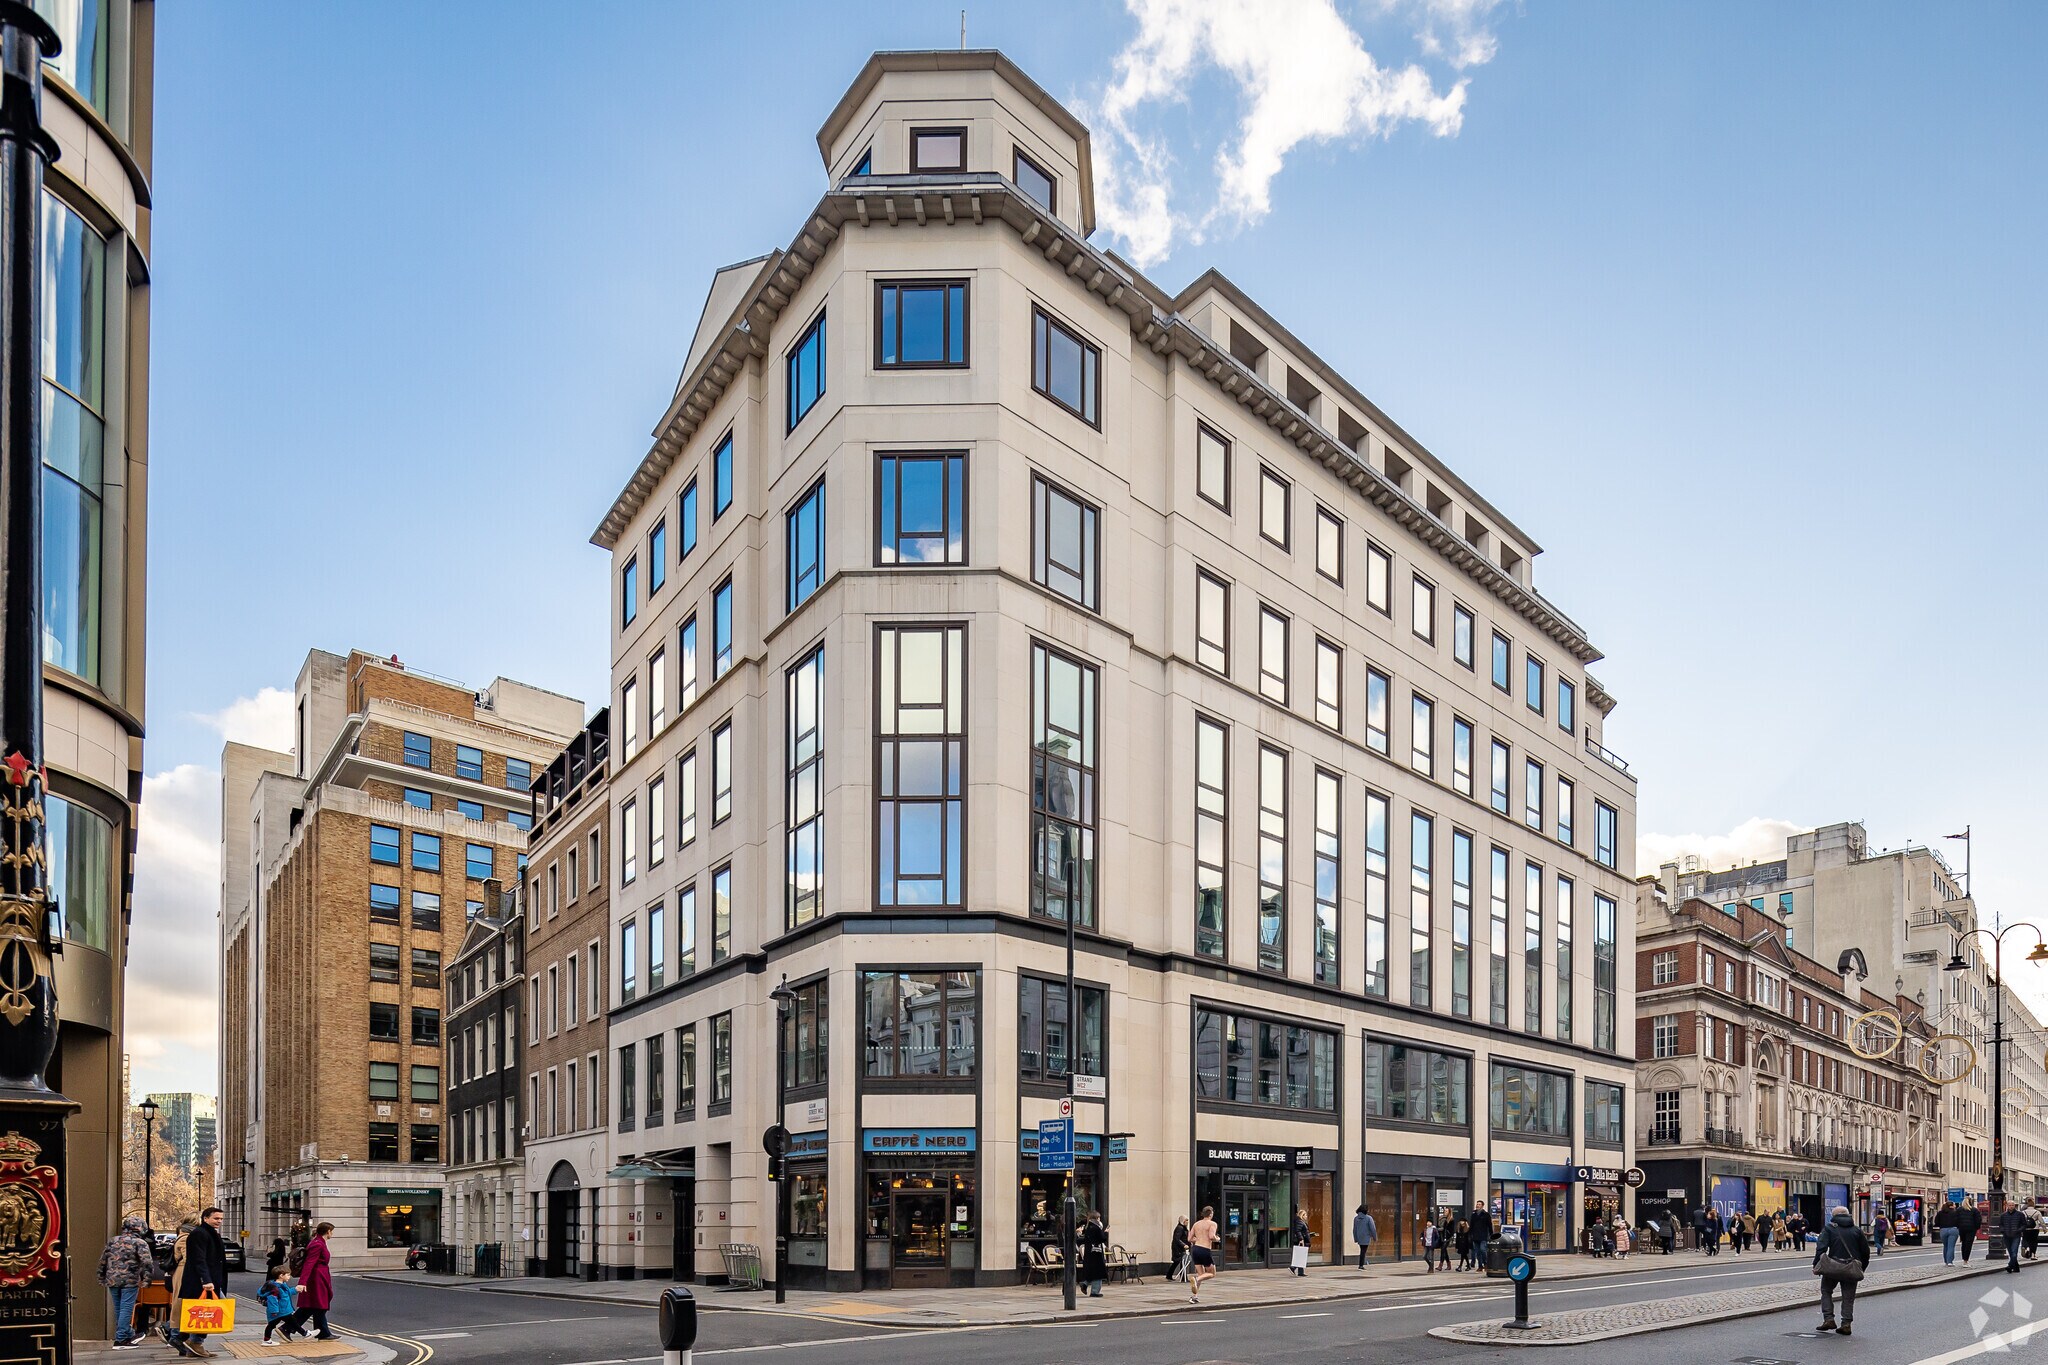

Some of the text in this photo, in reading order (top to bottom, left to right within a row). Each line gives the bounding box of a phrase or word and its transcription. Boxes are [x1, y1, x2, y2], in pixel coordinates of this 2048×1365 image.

[926, 1136, 967, 1147] NERO
[1208, 1149, 1286, 1162] BLANK STREET COFFEE
[1592, 1169, 1618, 1180] Bella Italia
[13, 1306, 56, 1317] FIELDS
